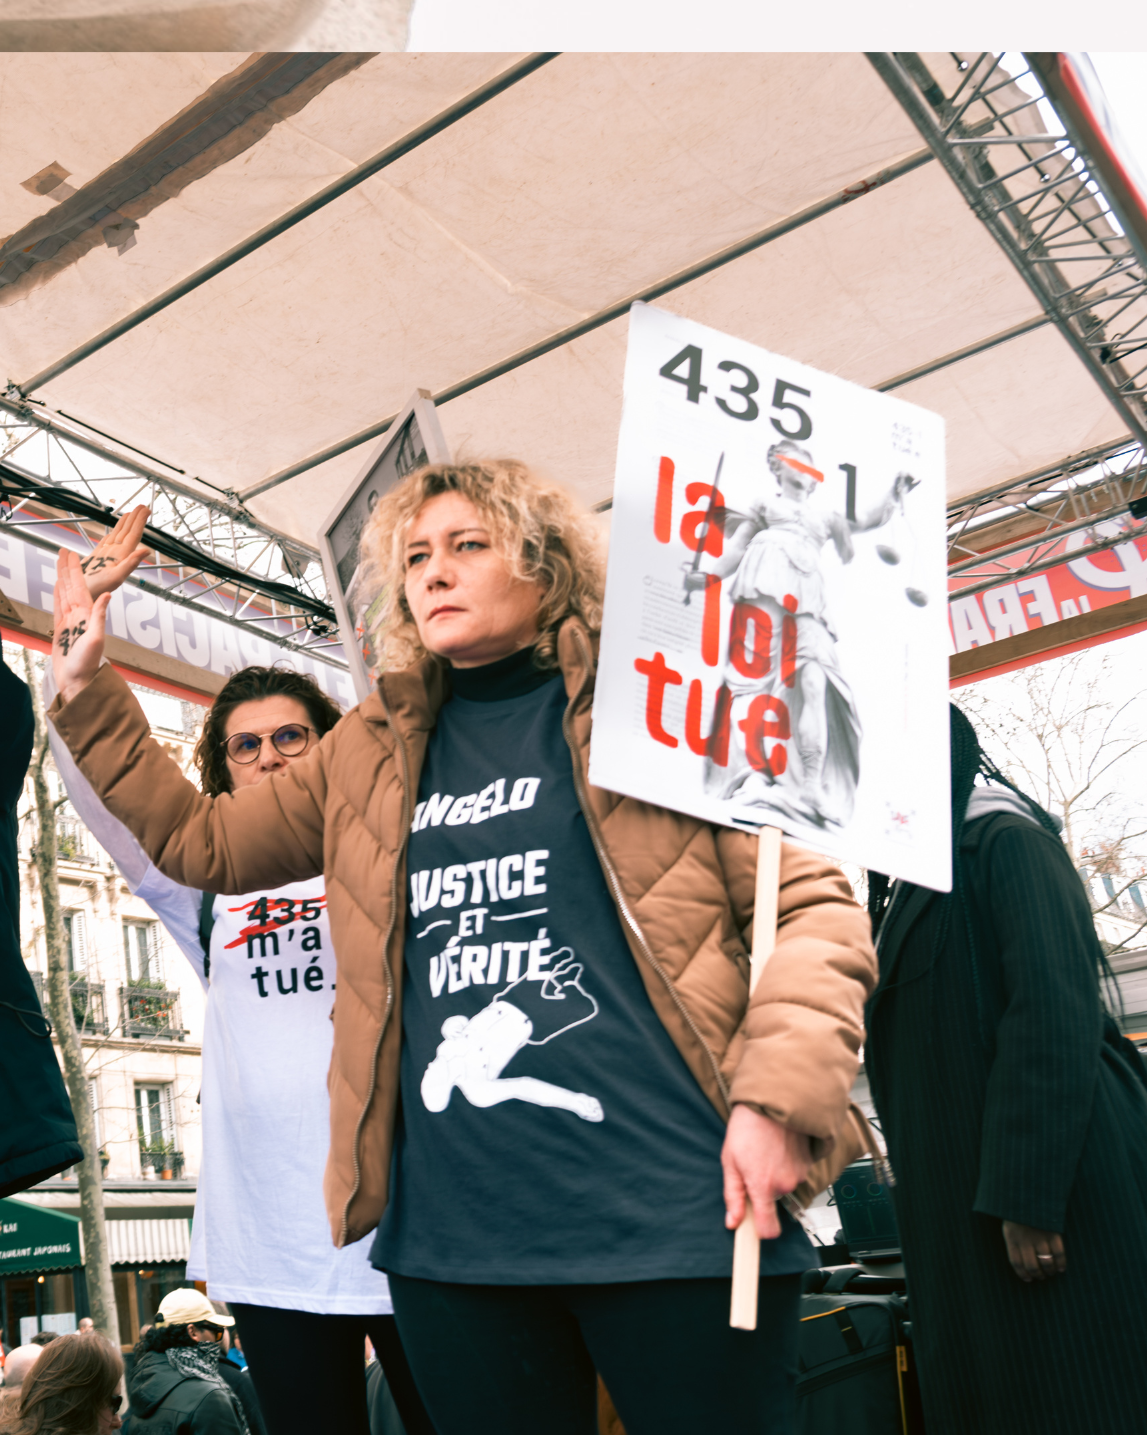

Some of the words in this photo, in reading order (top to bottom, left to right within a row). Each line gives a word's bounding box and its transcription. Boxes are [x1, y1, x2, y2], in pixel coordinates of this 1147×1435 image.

[659, 343, 813, 442] 435
[653, 455, 725, 559] la
[700, 573, 799, 690] loi
[633, 651, 792, 777] tue
[411, 777, 541, 834] ANGELO
[247, 896, 322, 927] 435
[410, 849, 550, 918] JUSTICE
[246, 926, 322, 959] m'a
[458, 908, 489, 937] ET
[429, 927, 552, 998] VÉRITÉ
[33, 1242, 71, 1256] JAPONAIS
